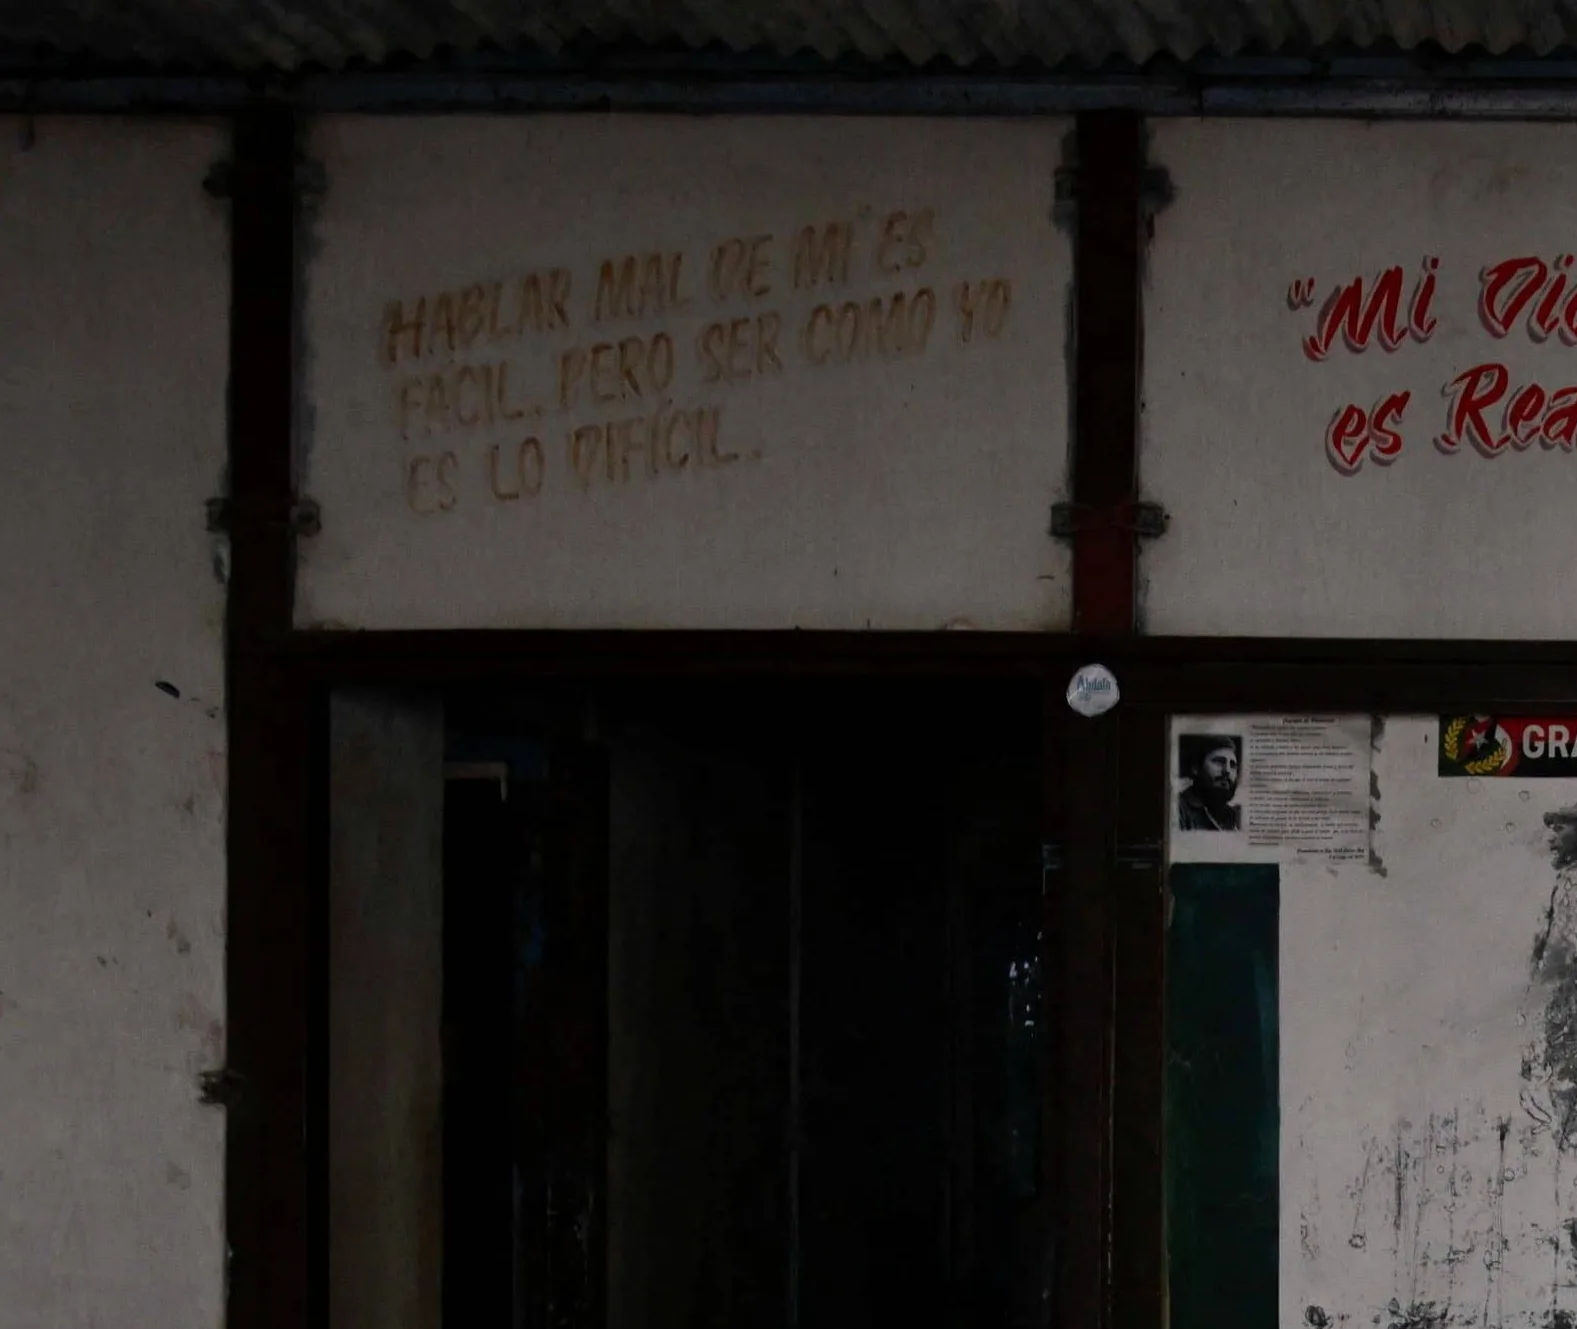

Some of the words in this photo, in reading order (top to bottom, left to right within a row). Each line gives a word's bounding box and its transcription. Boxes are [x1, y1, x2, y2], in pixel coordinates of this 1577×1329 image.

[380, 266, 571, 365] HABLAR
[595, 250, 688, 322] MAL
[709, 235, 774, 300] DE
[876, 207, 935, 275] ES
[558, 330, 674, 408] PERO
[698, 309, 786, 387] SER
[804, 284, 937, 368] COMO
[957, 276, 1014, 345] YO
[406, 448, 458, 517] ES
[489, 435, 547, 503] LO
[1326, 390, 1412, 476] es
